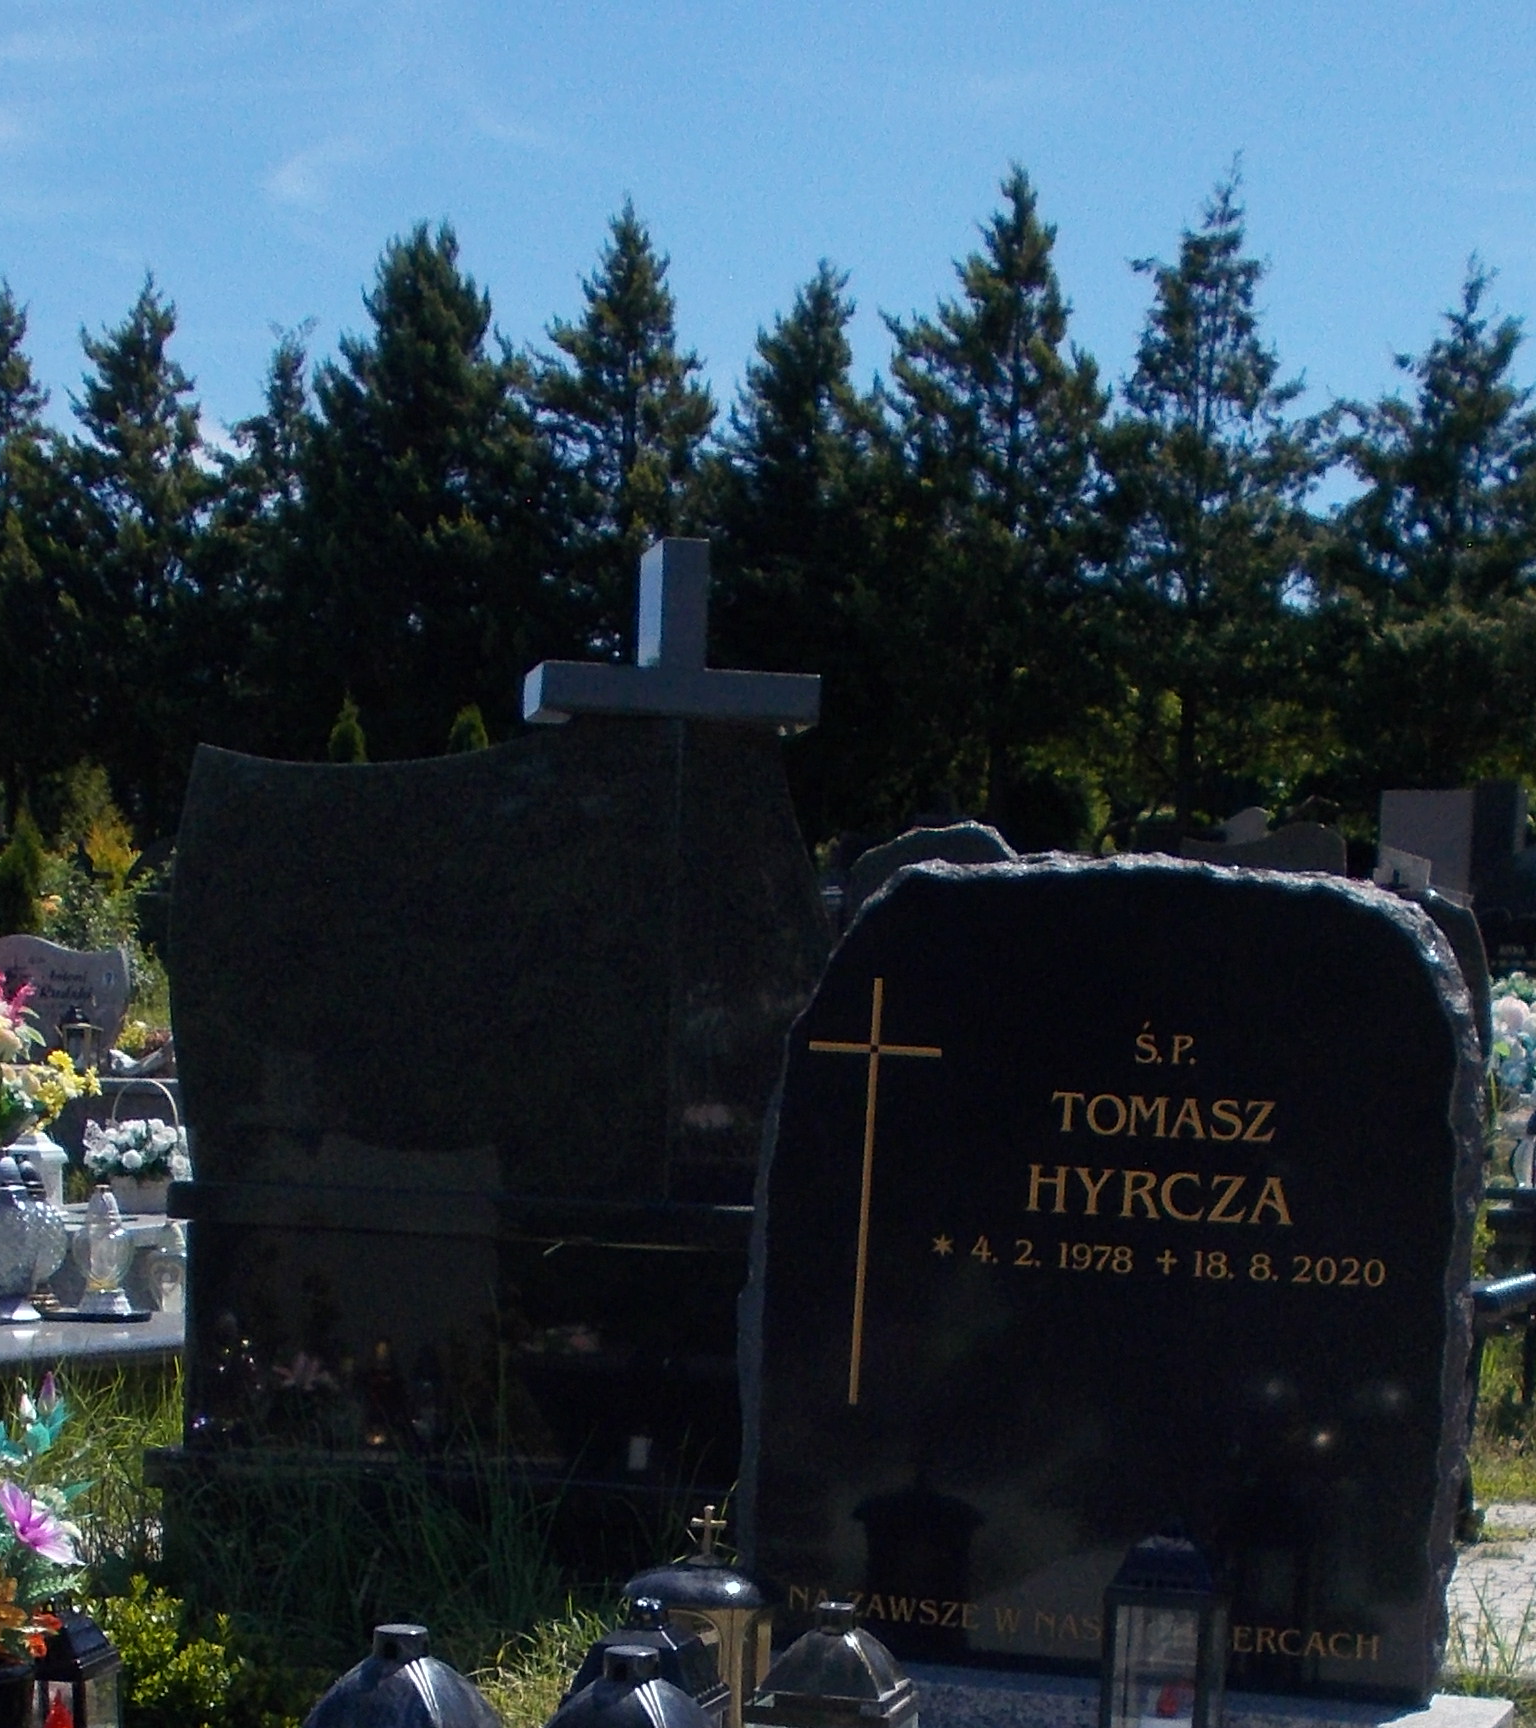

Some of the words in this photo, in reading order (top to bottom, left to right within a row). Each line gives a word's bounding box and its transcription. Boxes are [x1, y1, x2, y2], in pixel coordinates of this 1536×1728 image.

[1050, 1090, 1277, 1143] TOMASZ
[1025, 1163, 1295, 1227] HYRCZA
[1058, 1241, 1134, 1275] 1978
[1291, 1255, 1387, 1288] 2020
[994, 1605, 1024, 1635] W
[1231, 1624, 1381, 1662] ERCACH
